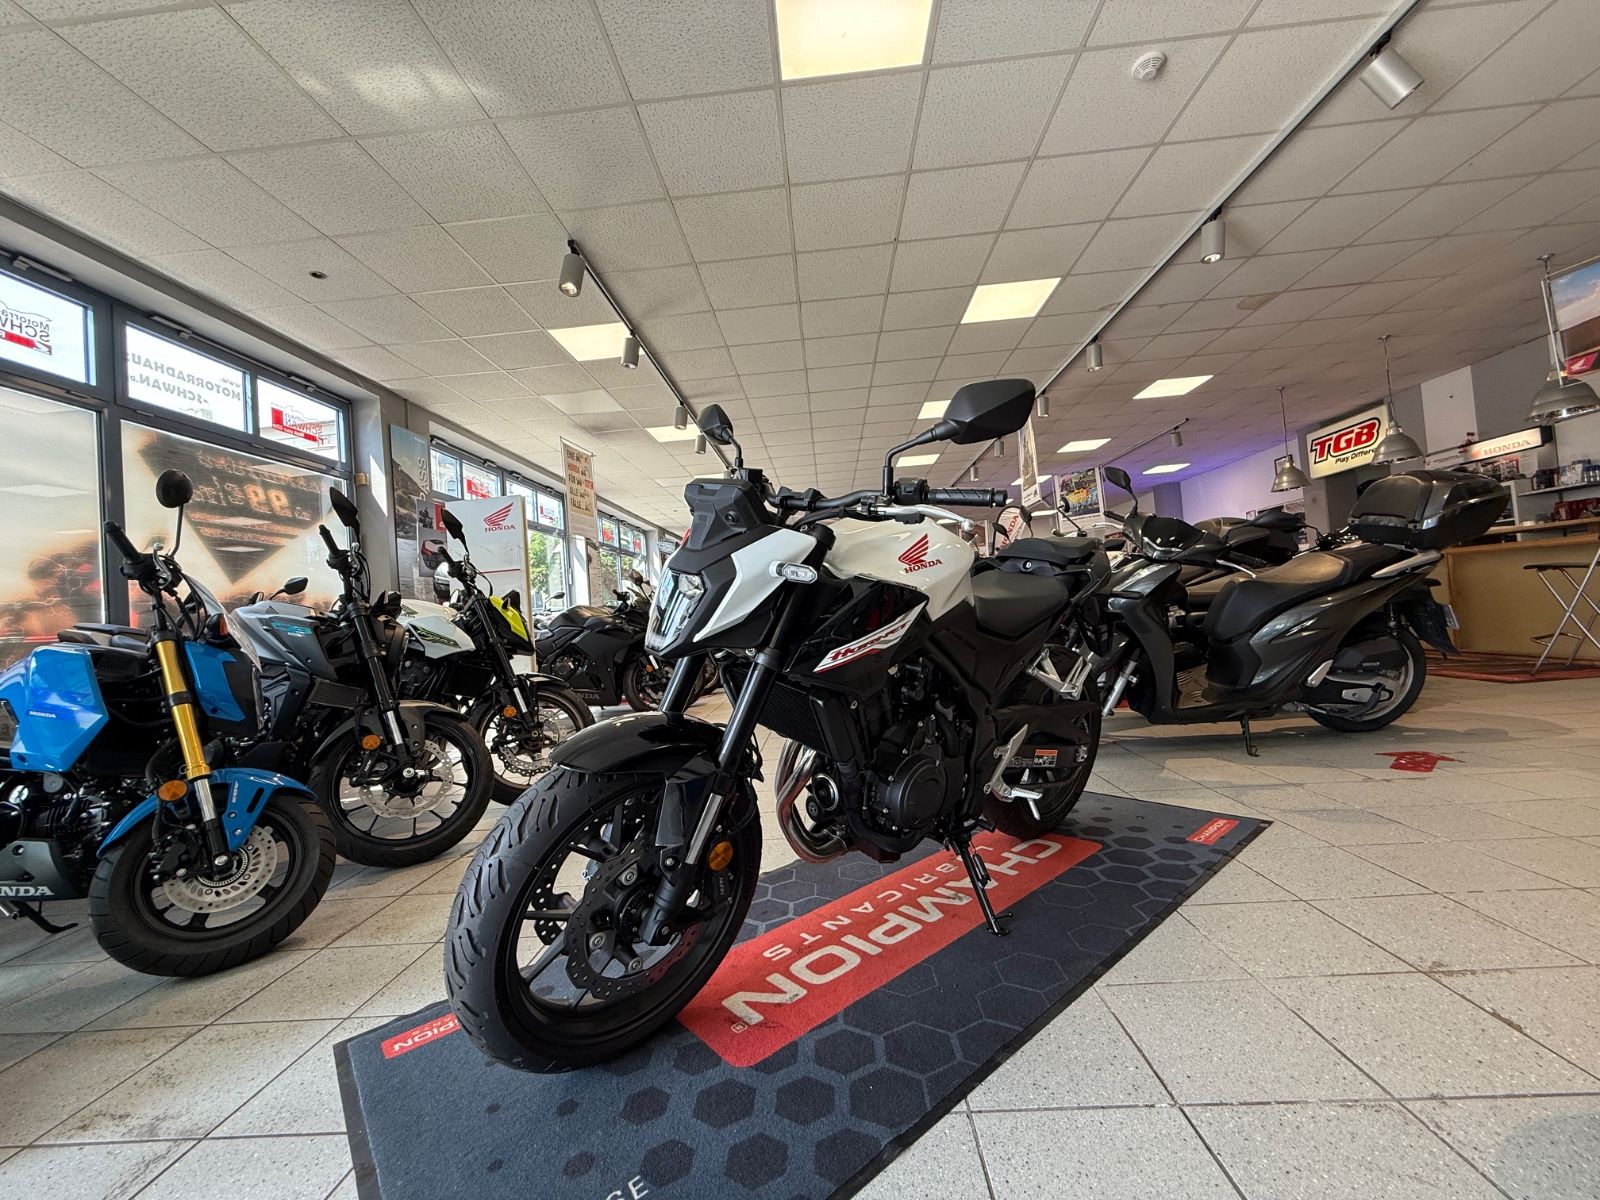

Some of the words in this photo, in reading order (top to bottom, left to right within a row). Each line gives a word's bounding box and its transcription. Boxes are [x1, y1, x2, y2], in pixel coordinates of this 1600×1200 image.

[1311, 418, 1379, 462] TGB
[1483, 439, 1532, 456] HONDA
[1335, 453, 1350, 464] Play
[484, 524, 516, 533] HONDA
[903, 558, 943, 574] HONDA
[29, 710, 57, 719] HONDA
[0, 886, 56, 897] NDA
[763, 845, 994, 961] LBRICANTS
[721, 838, 1063, 1026] CHAMPION
[391, 1018, 459, 1052] PION
